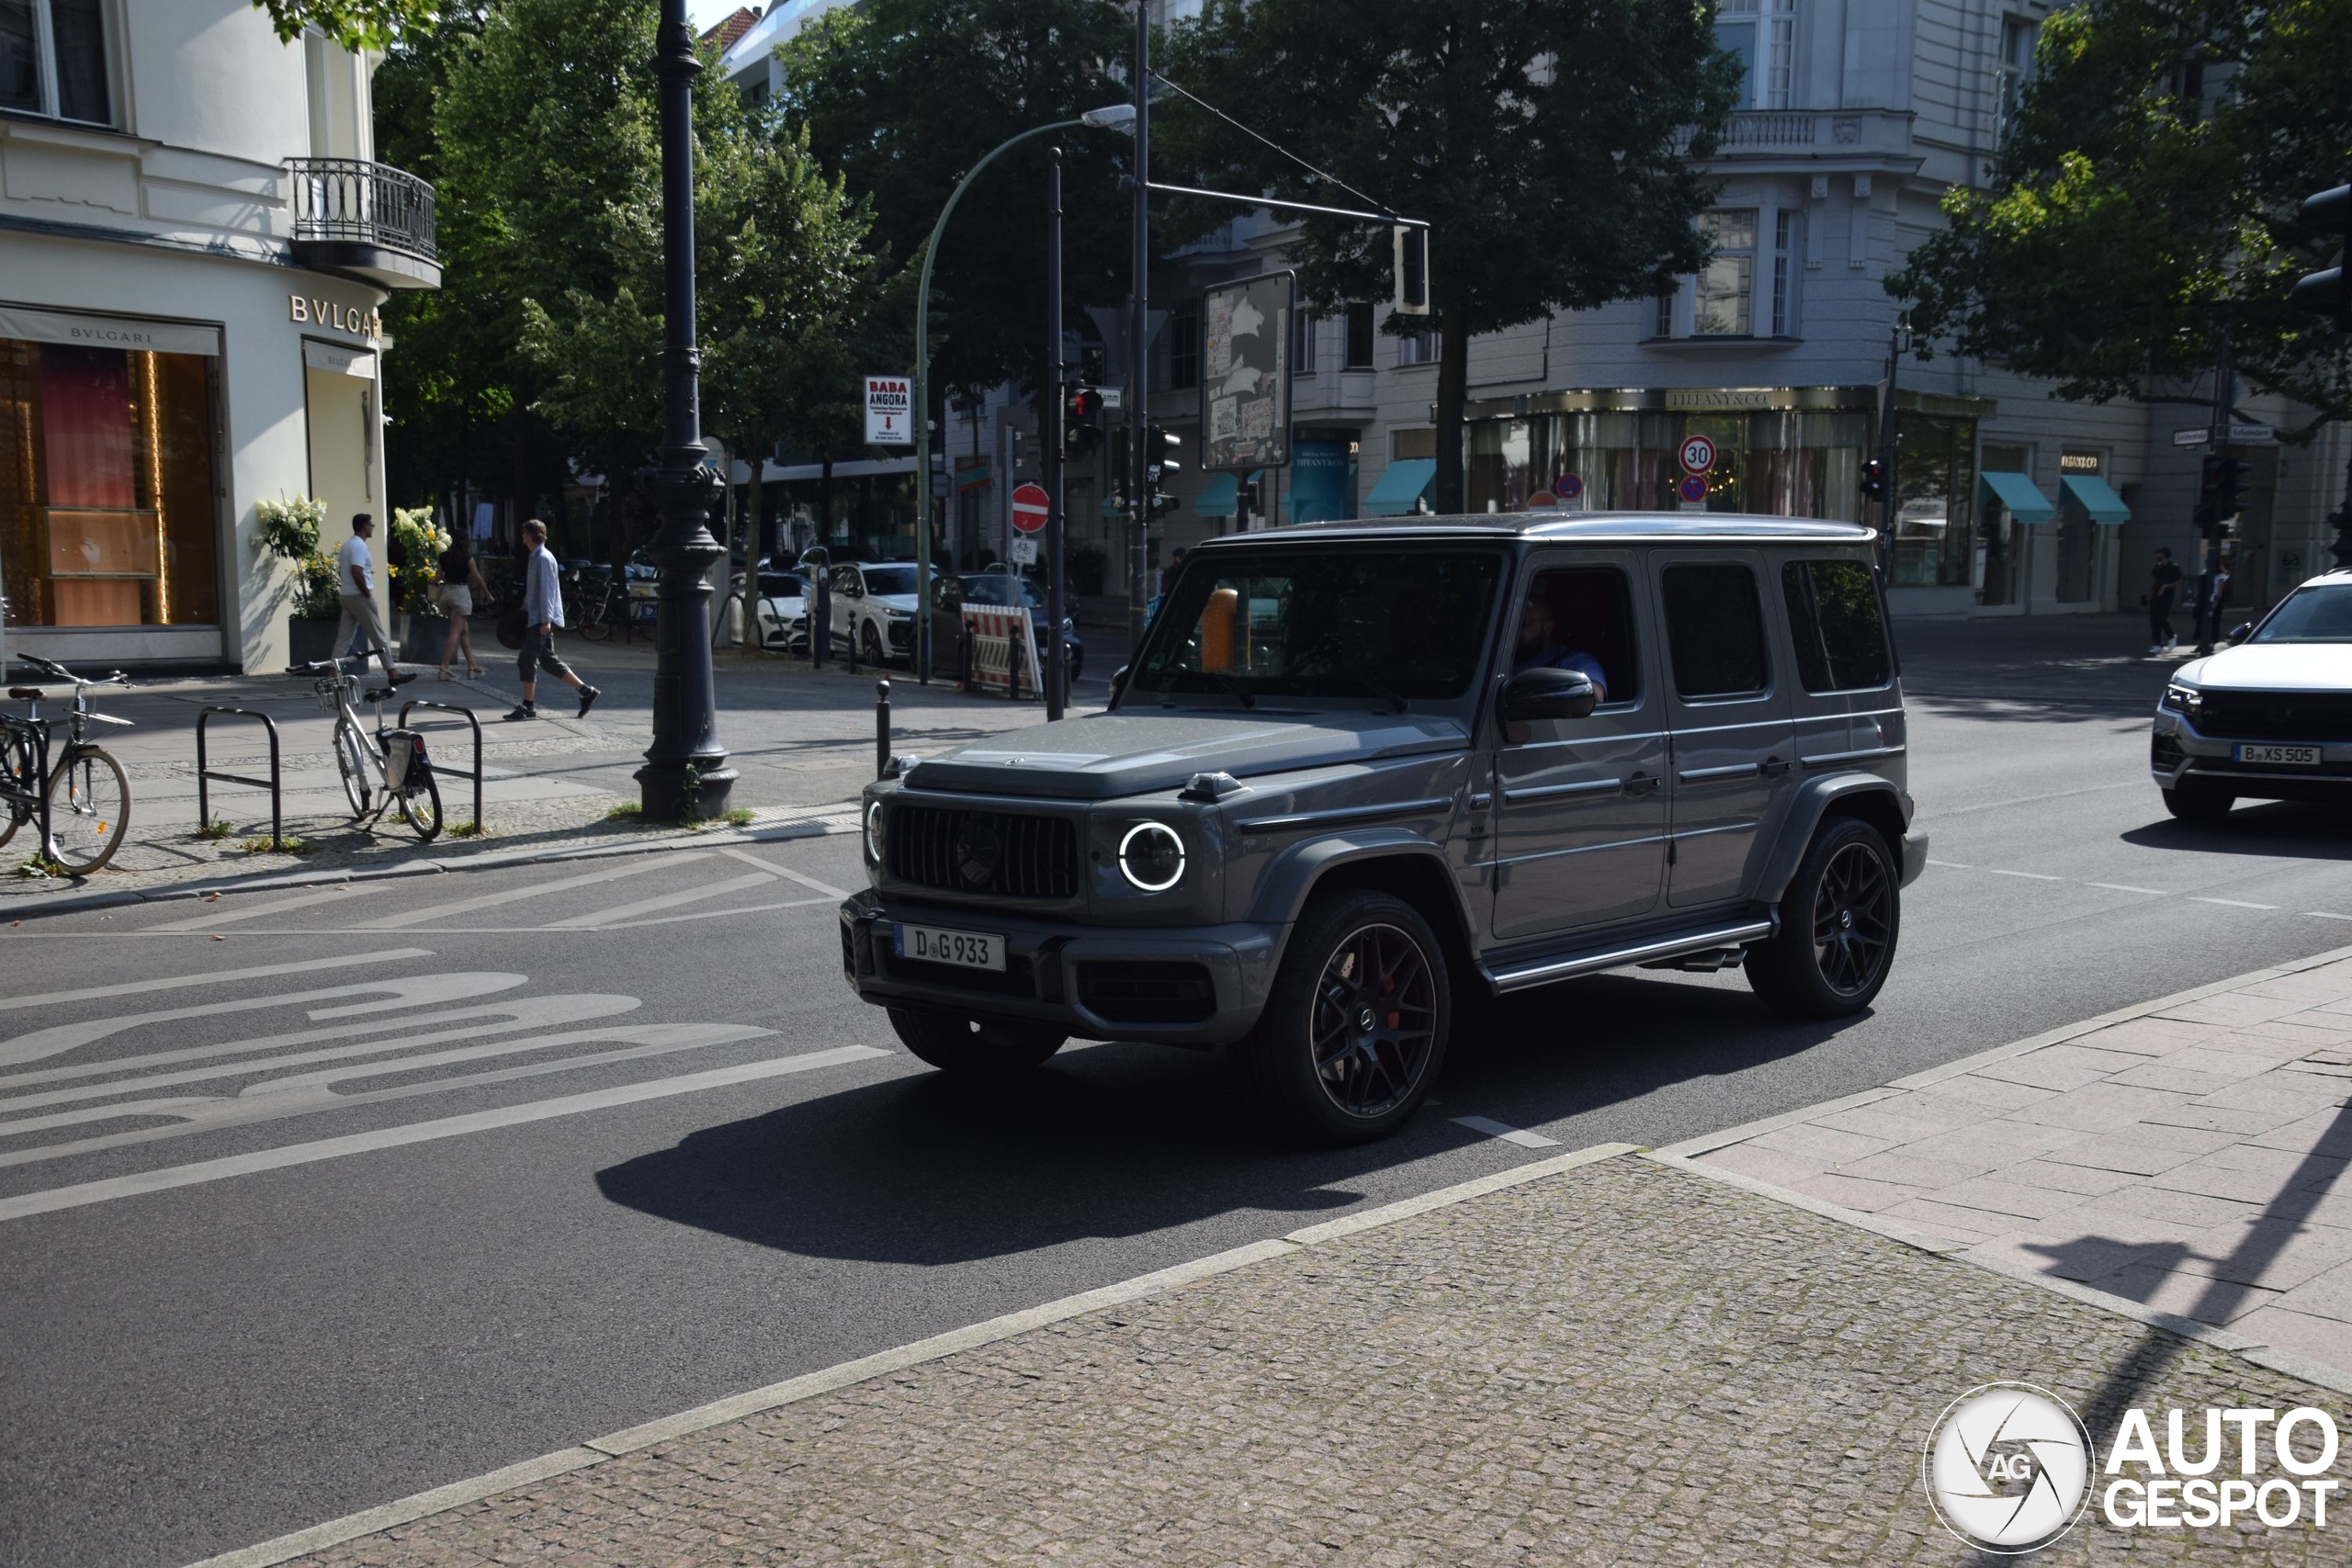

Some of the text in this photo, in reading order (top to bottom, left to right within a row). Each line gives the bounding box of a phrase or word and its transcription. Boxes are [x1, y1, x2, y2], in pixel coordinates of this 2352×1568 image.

[71, 327, 151, 344] BVLGARI
[869, 381, 908, 394] BABA
[869, 393, 908, 406] ANGORA
[1100, 391, 1119, 402] amm
[1688, 446, 1708, 464] 30
[2245, 747, 2312, 762] B XS 505
[915, 930, 927, 955] D
